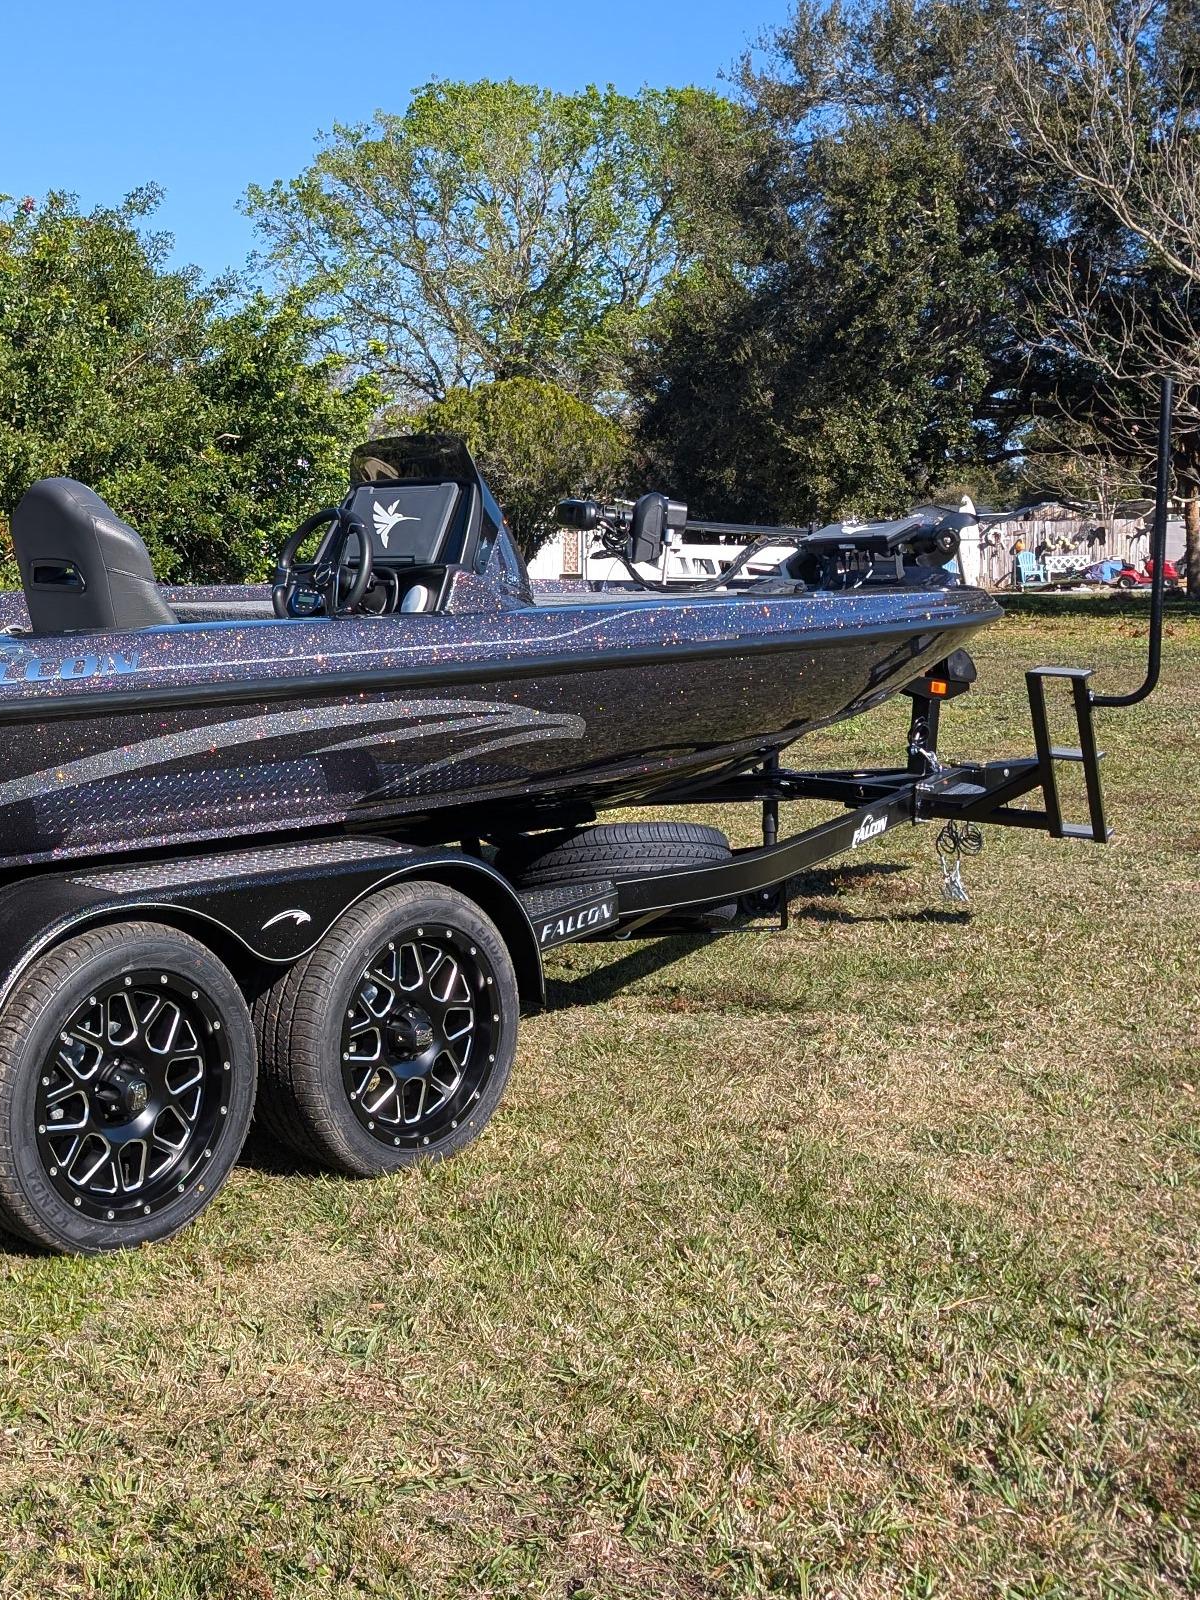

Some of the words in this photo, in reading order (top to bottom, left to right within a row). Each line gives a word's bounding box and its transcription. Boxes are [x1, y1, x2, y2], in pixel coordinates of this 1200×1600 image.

[852, 815, 888, 848] FALCON
[540, 903, 614, 943] FALCON
[26, 1168, 70, 1229] KENDA
